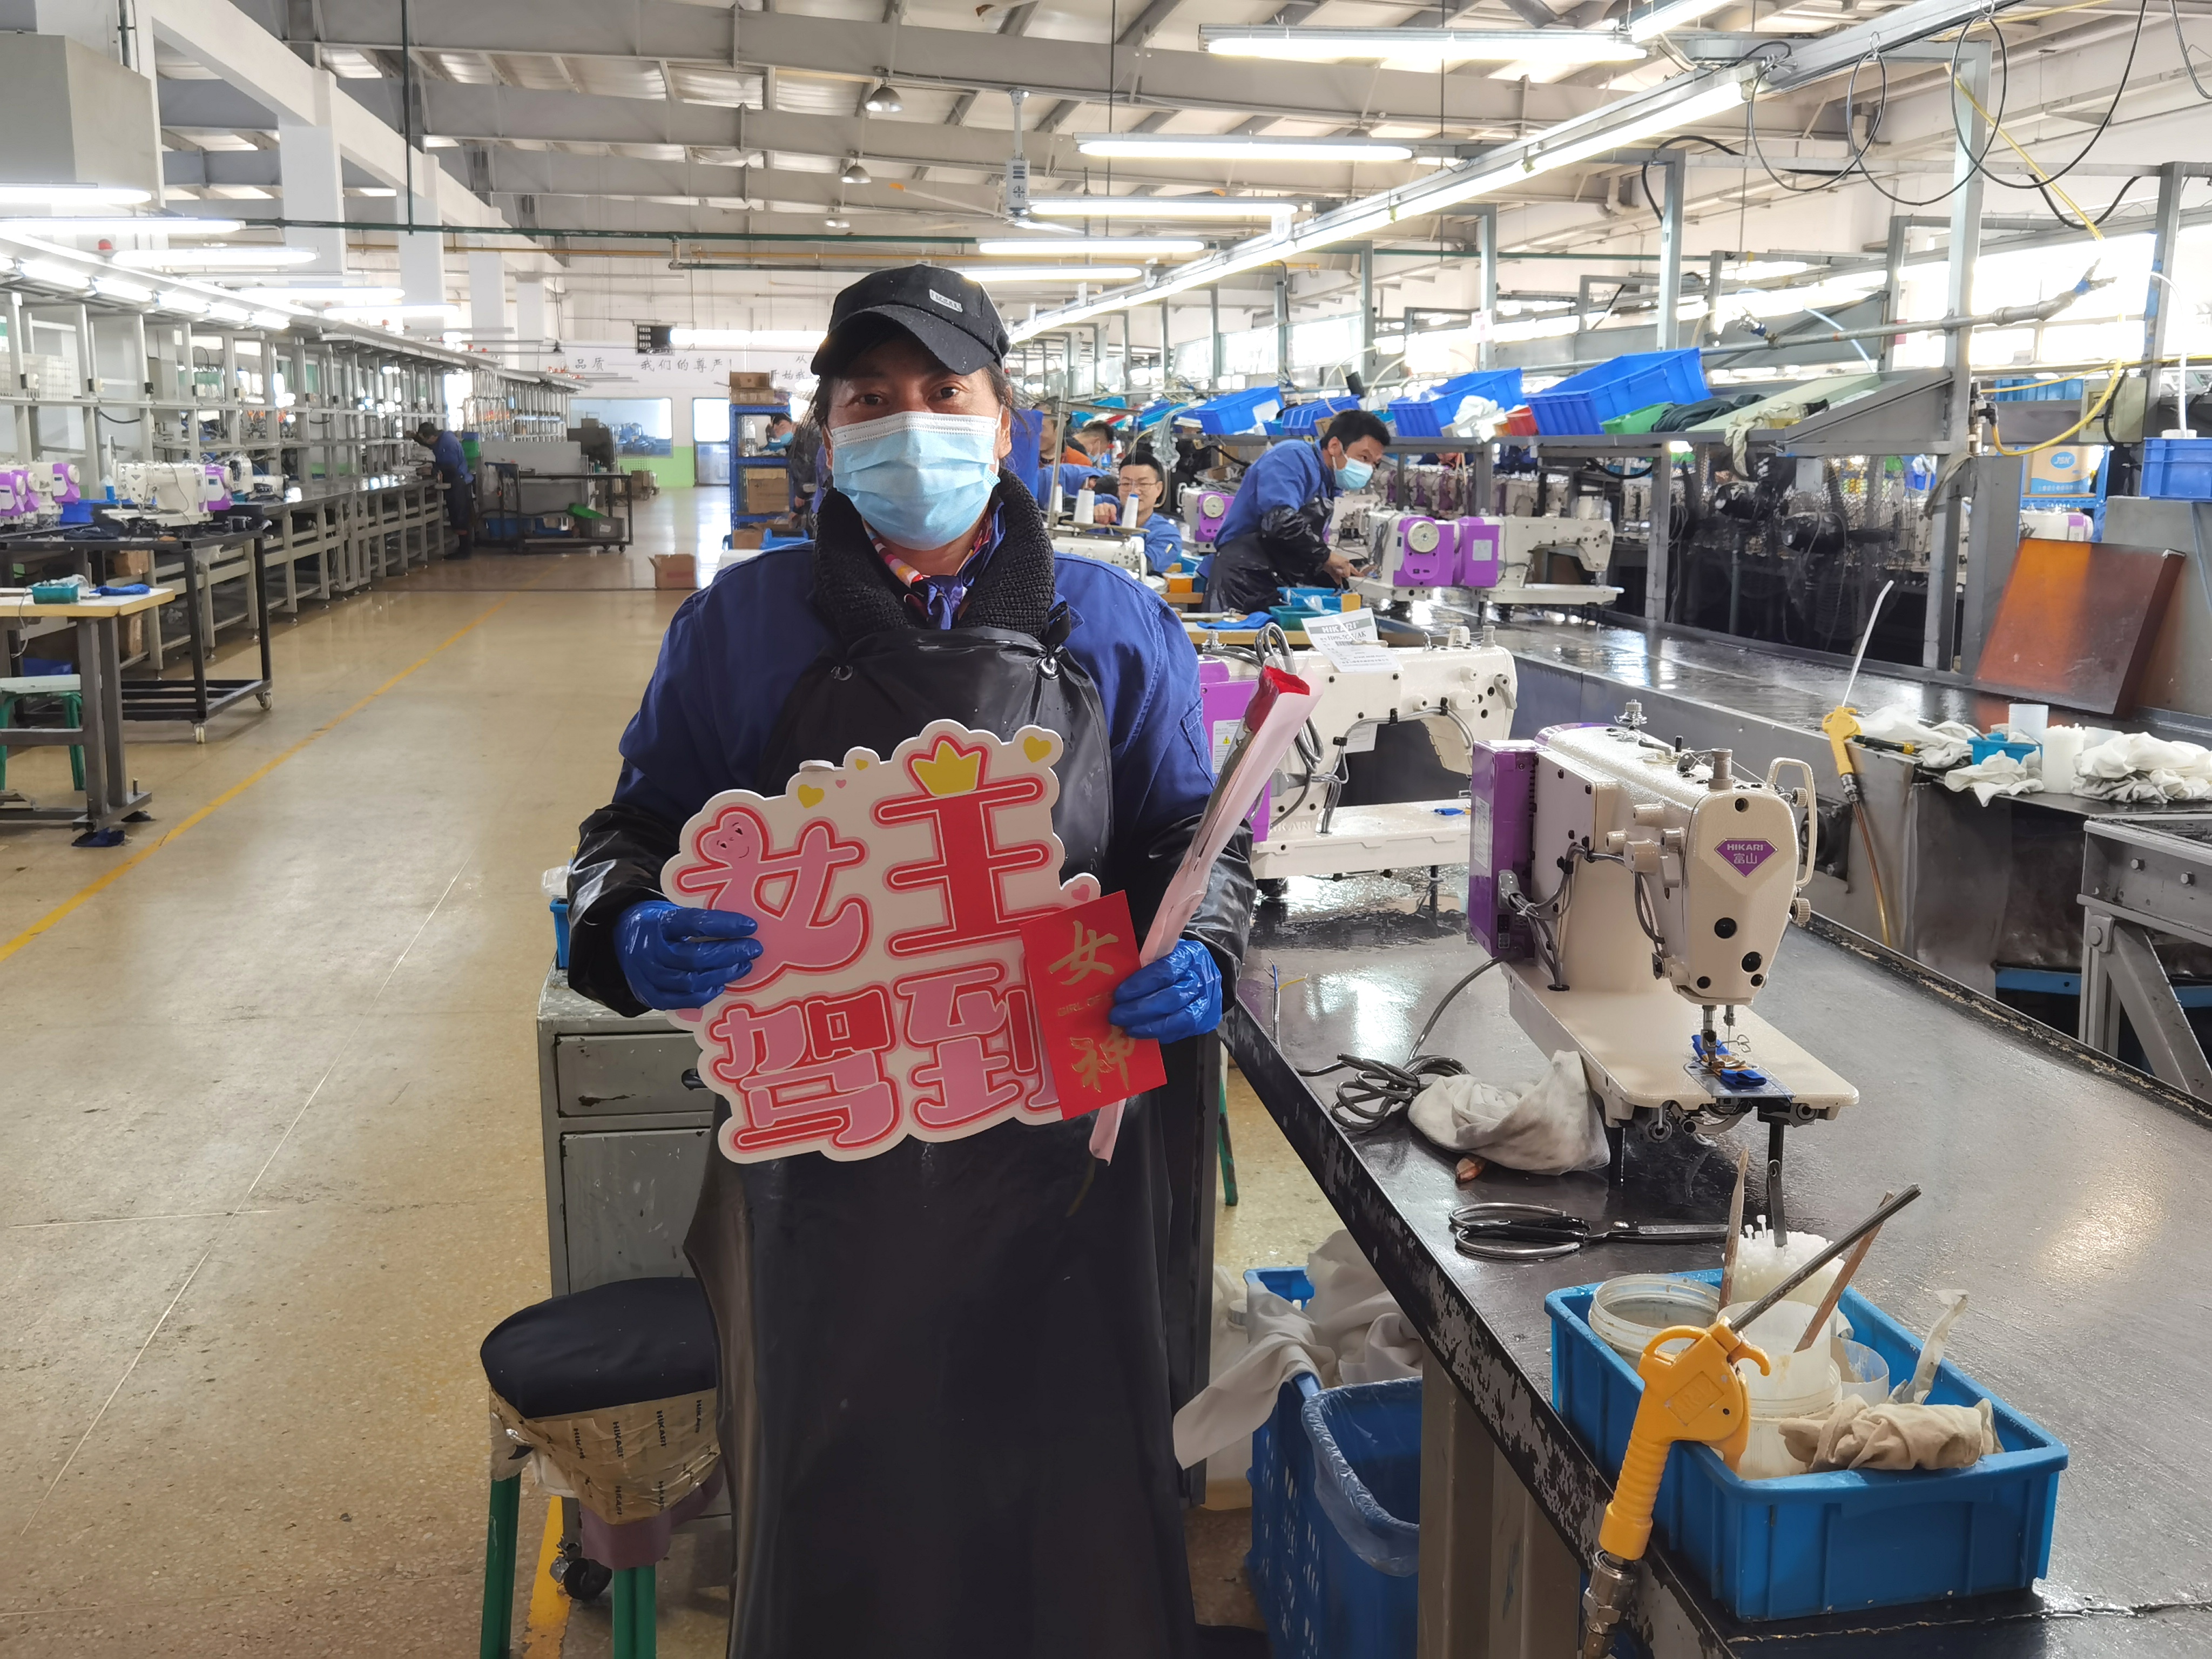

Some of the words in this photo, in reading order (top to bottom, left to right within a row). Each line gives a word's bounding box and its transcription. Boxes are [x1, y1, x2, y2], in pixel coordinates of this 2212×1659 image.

[1321, 622, 1357, 633] HIKARI
[1733, 853, 1758, 864] 富山
[1057, 1002, 1084, 1017] GIRL
[710, 959, 1064, 1154] 驾到
[613, 1421, 624, 1458] HIKARI
[657, 1410, 667, 1447] HIKARI
